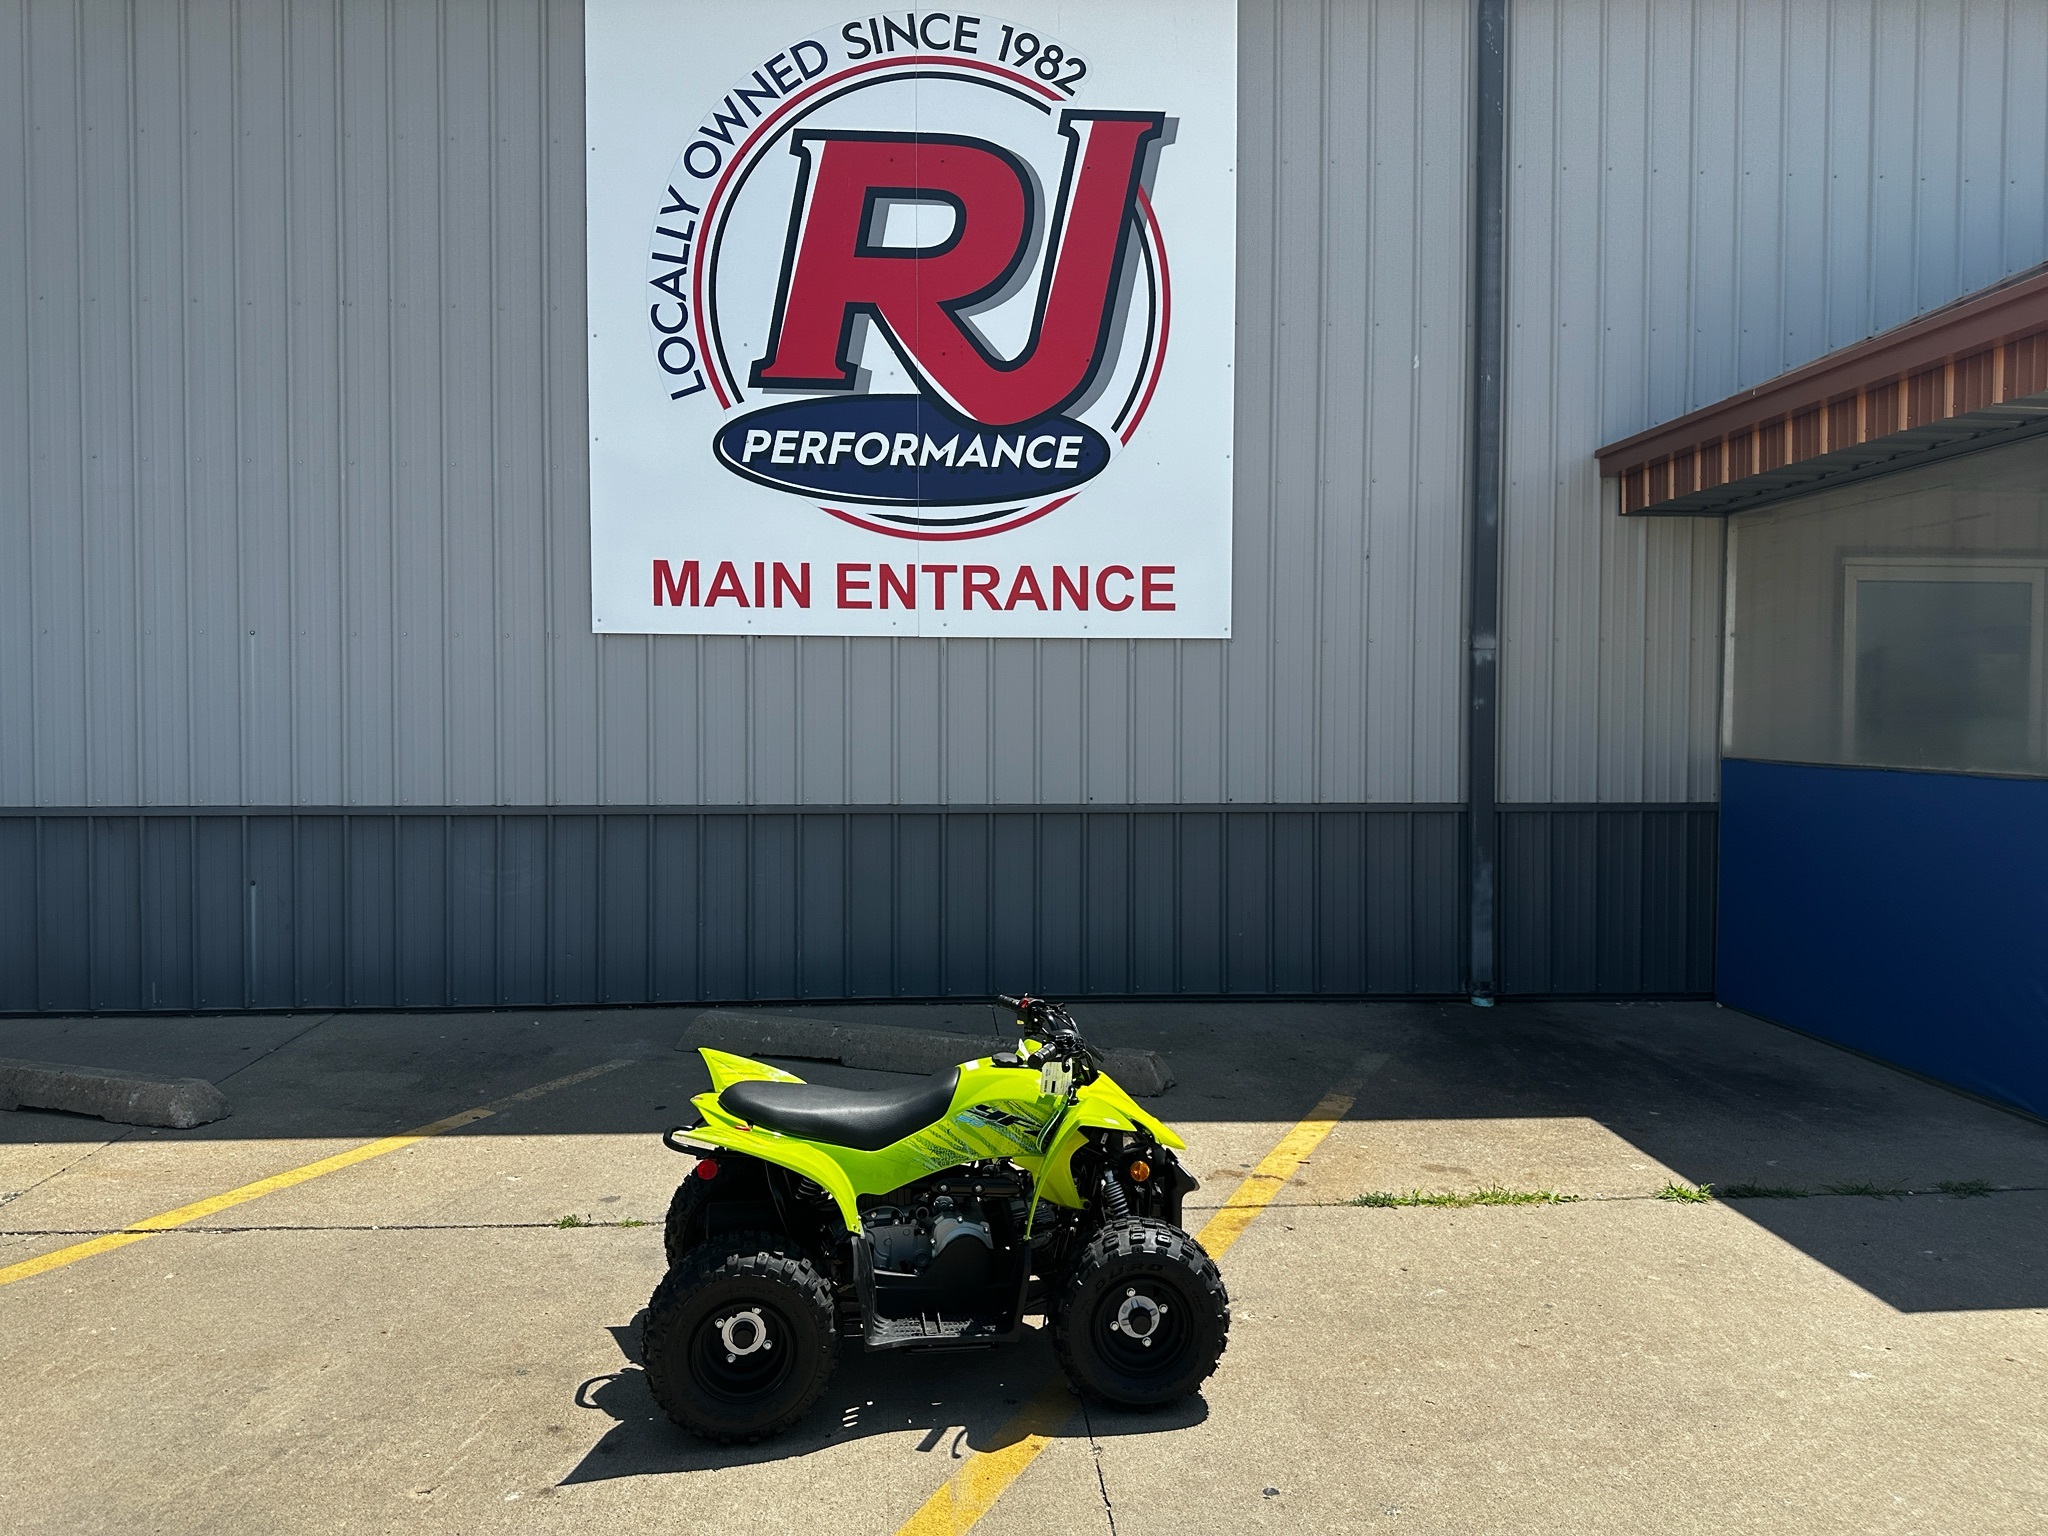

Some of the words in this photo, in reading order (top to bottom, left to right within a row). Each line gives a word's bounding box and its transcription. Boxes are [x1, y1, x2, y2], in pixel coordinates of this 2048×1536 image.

[649, 185, 707, 401] LOCALLY
[683, 40, 829, 180] OWNED
[841, 13, 981, 60] SINCE
[998, 25, 1087, 97] 1982
[748, 109, 1168, 427] RJ
[741, 429, 1084, 469] PERFORMANCE
[653, 559, 811, 608] MAIN
[836, 563, 1176, 611] ENTRANCE
[1095, 1262, 1164, 1292] DURO
